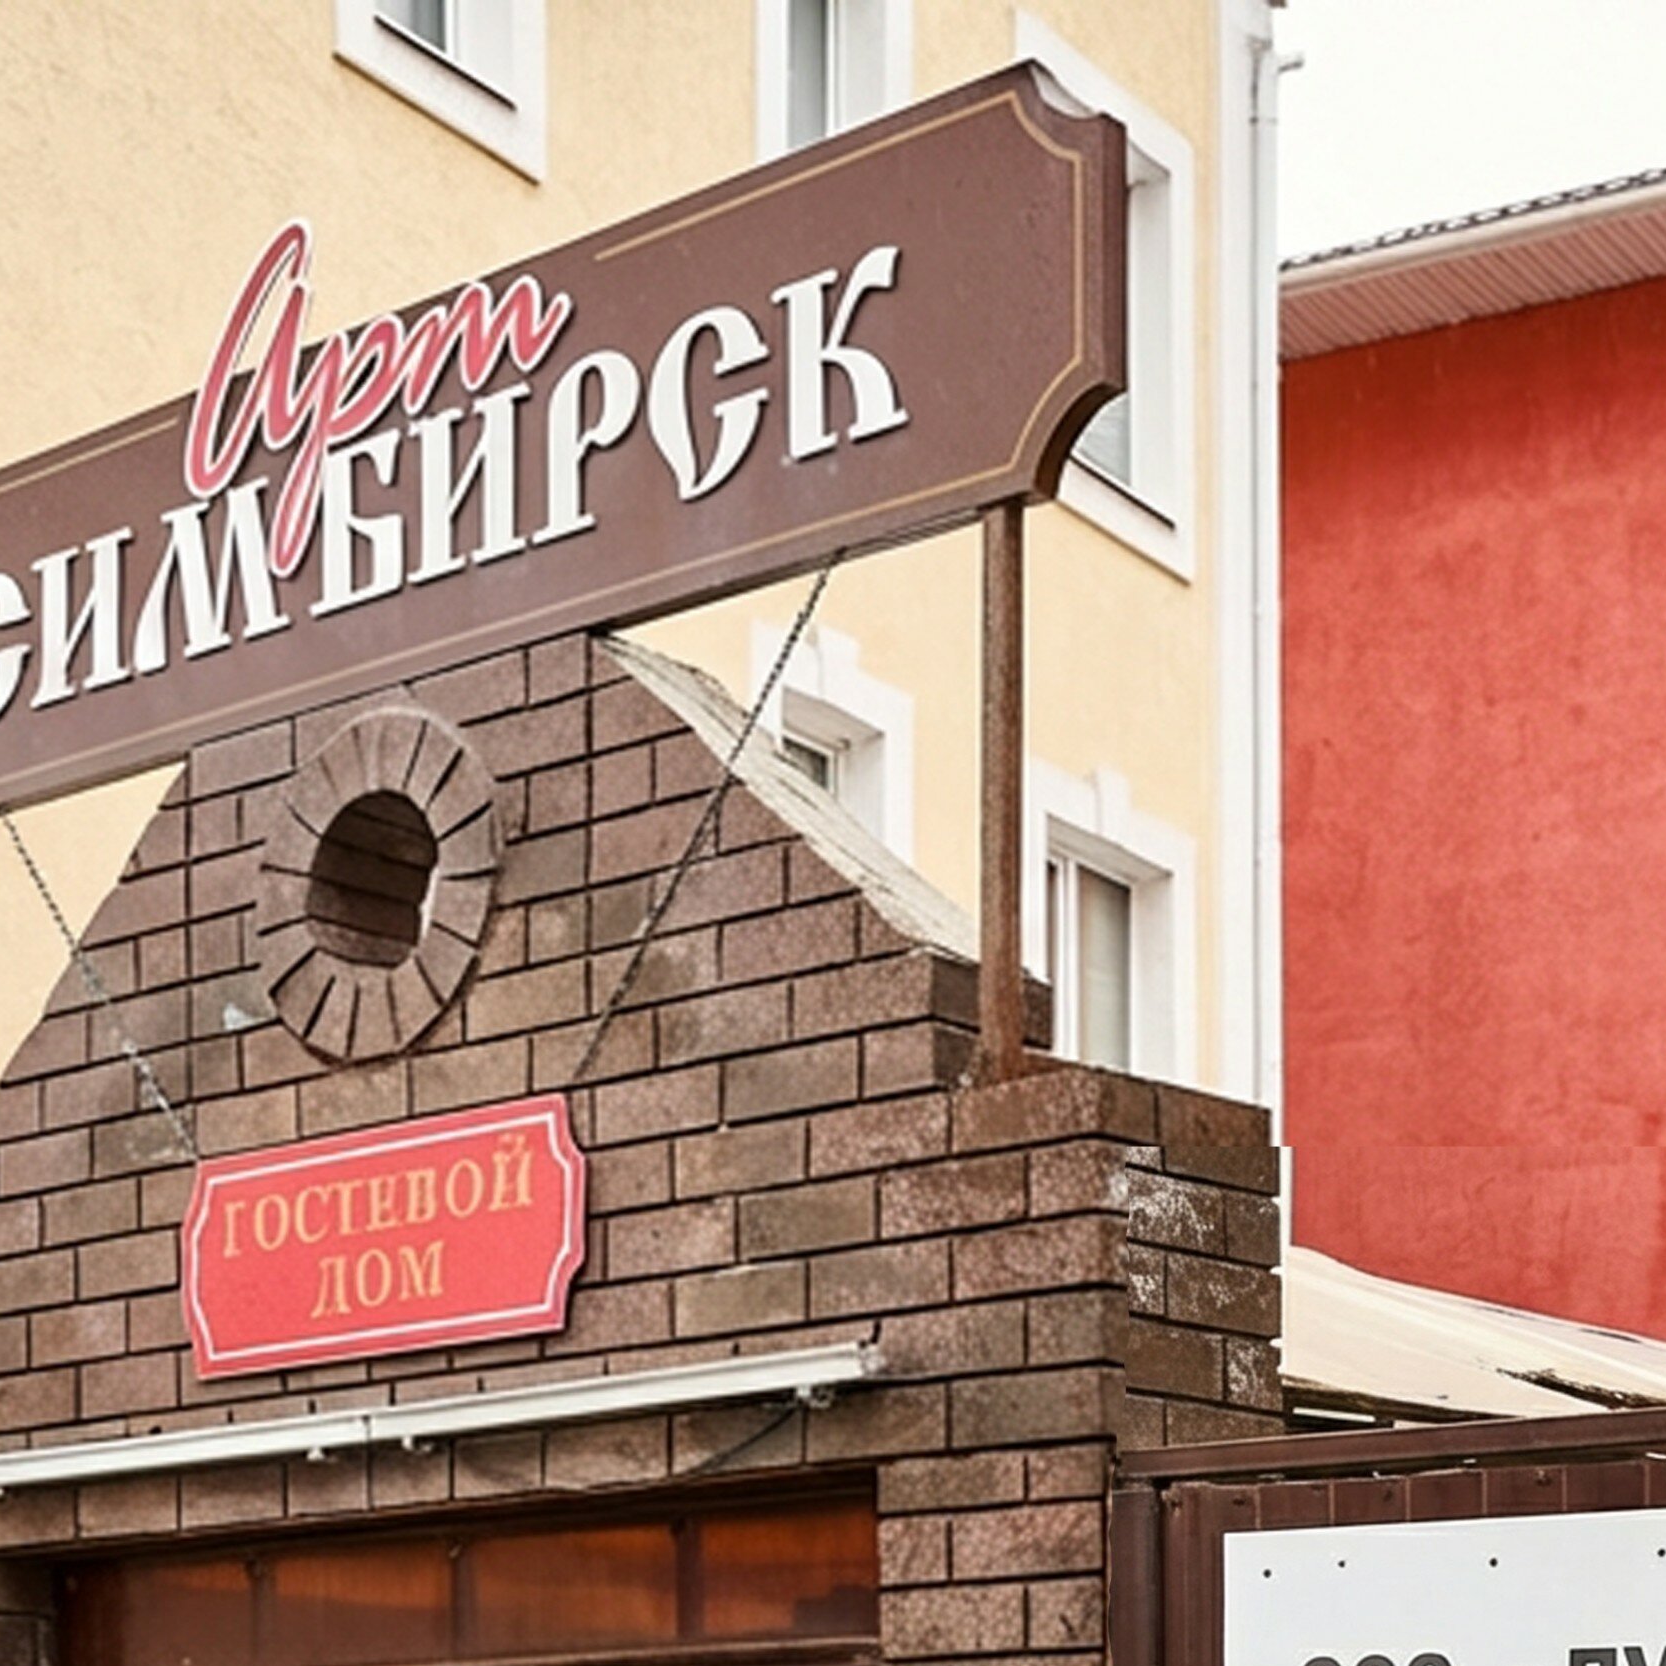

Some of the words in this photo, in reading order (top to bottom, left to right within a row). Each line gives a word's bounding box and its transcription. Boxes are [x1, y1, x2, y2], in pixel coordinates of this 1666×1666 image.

[185, 219, 573, 577] Арт
[222, 1132, 533, 1258] ГОСТЕВОЙ
[310, 1241, 444, 1318] ДОМ
